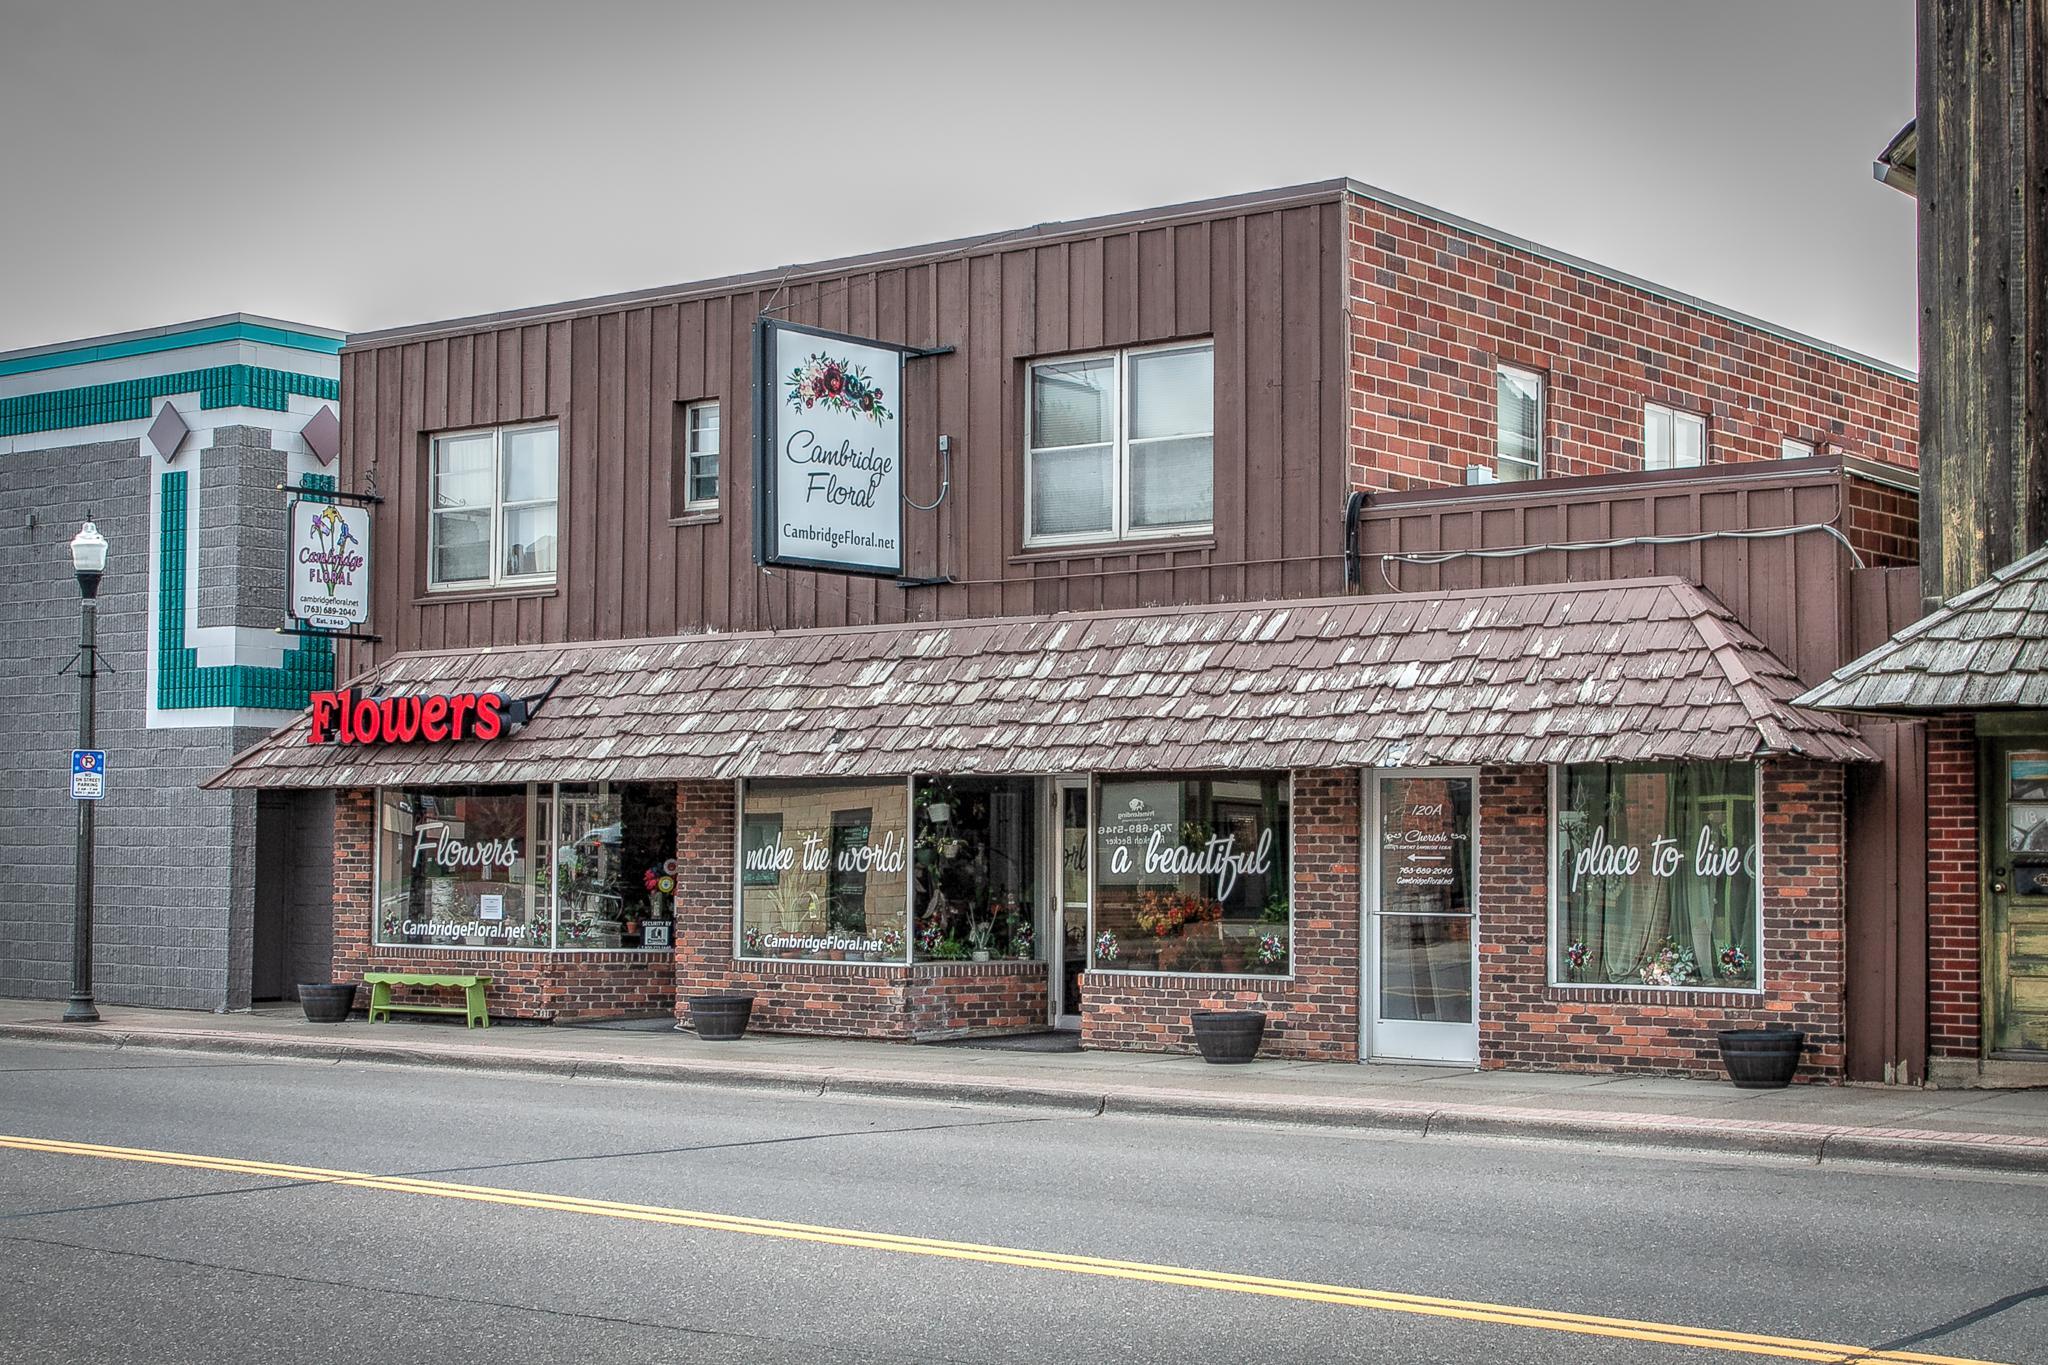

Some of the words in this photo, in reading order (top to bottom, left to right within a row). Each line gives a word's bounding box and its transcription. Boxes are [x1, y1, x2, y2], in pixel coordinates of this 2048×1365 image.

[786, 430, 893, 487] Cambridge
[806, 472, 877, 508] Floral
[783, 523, 895, 550] CambridgeFloral.net
[299, 547, 364, 572] Cambridge
[309, 568, 353, 586] FLORAL
[300, 595, 359, 607] cambridgefloral.net
[303, 604, 322, 614] (763)
[323, 606, 357, 616] 689-2040
[307, 688, 502, 744] Flowers
[1411, 804, 1442, 816] 120A
[412, 822, 519, 868] Flowers
[1404, 829, 1449, 843] Cherish
[745, 831, 795, 872] make
[801, 834, 831, 872] the
[837, 830, 905, 873] world
[1111, 845, 1133, 874] a
[1145, 827, 1272, 902] beautiful
[1571, 825, 1641, 893] place
[1651, 834, 1685, 877] to
[1695, 824, 1741, 876] live
[402, 919, 526, 941] CambridgeFloral.net
[763, 933, 884, 953] CambridgeFloral.net
